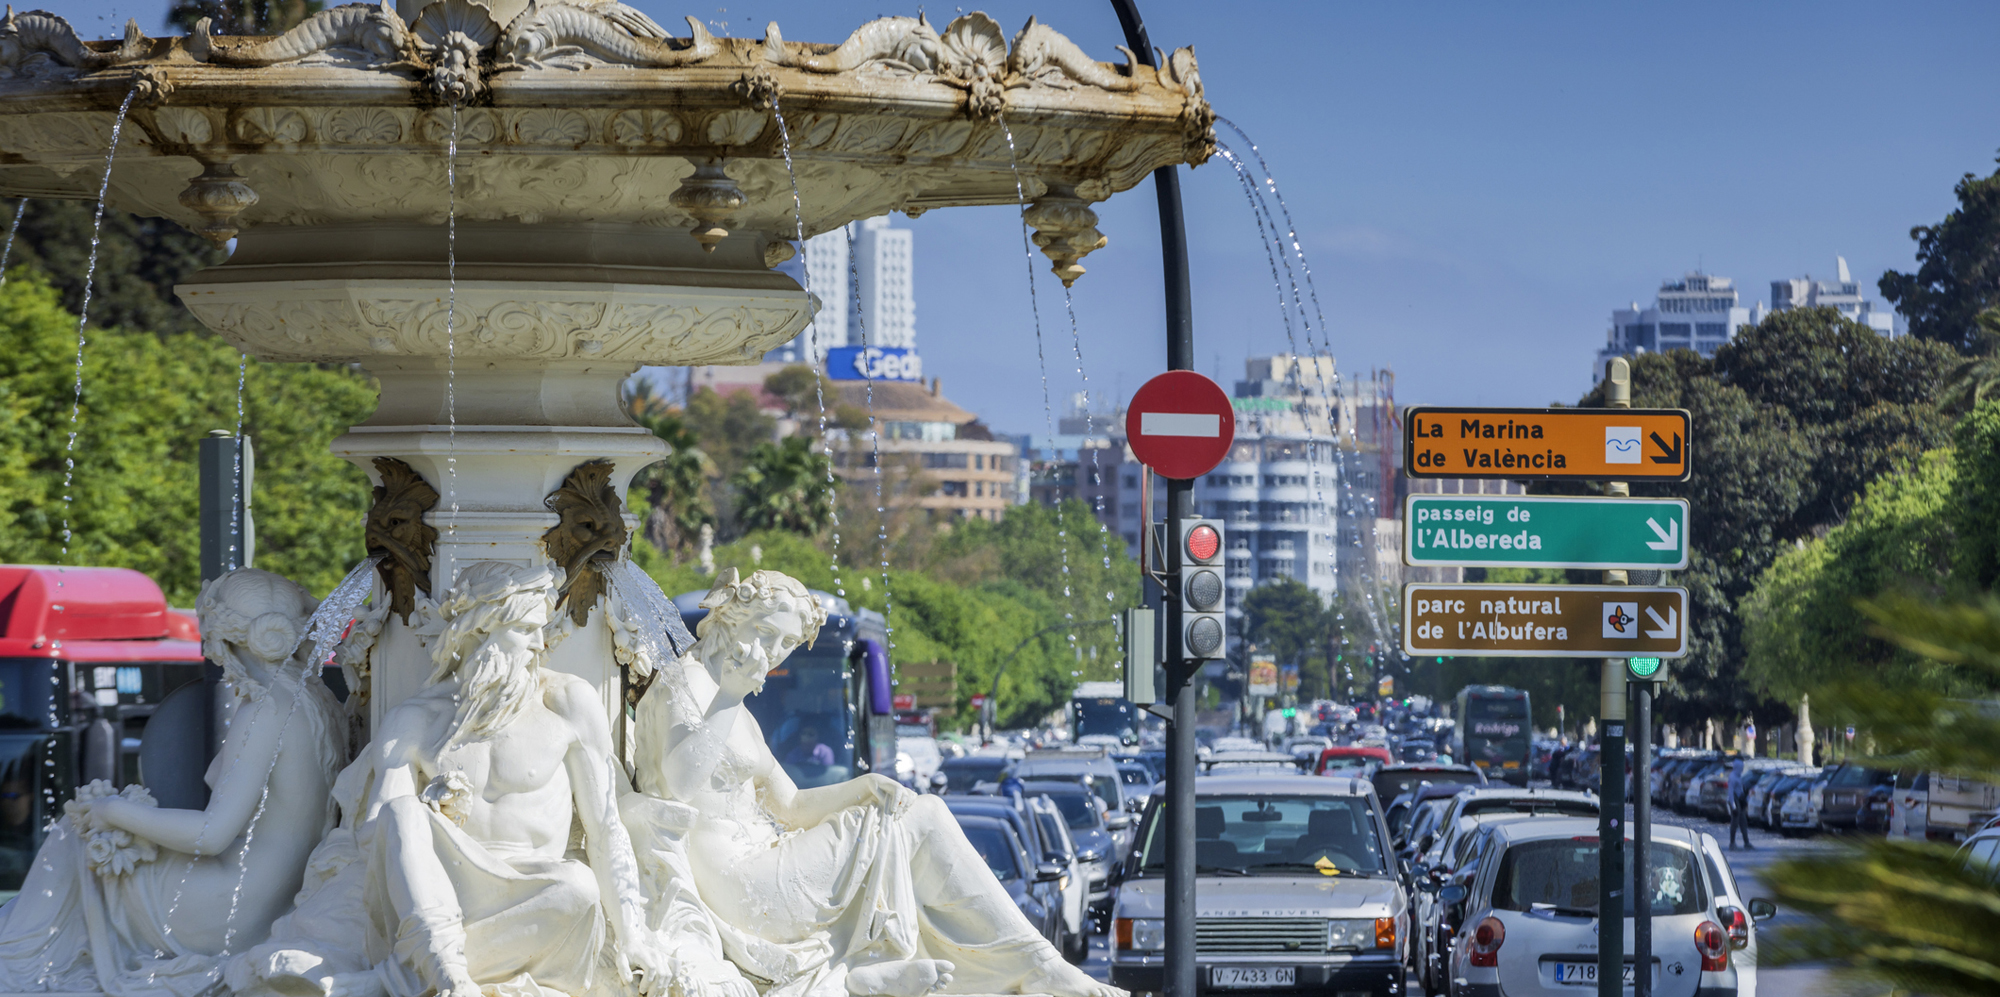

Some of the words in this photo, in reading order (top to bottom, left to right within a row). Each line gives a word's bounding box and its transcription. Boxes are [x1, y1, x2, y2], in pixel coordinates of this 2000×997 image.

[1416, 418, 1444, 438] La
[1460, 419, 1544, 440] Marina
[1416, 449, 1446, 467] de
[1463, 448, 1567, 469] València
[1417, 505, 1494, 525] passeig
[1507, 505, 1531, 522] de
[1417, 528, 1542, 550] l'Albereda
[1417, 599, 1466, 617] parc
[1480, 597, 1562, 616] natural
[1417, 621, 1444, 639] de
[1458, 621, 1568, 640] l'Albufera
[1215, 970, 1223, 983] V
[1231, 970, 1267, 983] 7433
[1275, 970, 1294, 983] GN
[1567, 965, 1599, 980] 718
